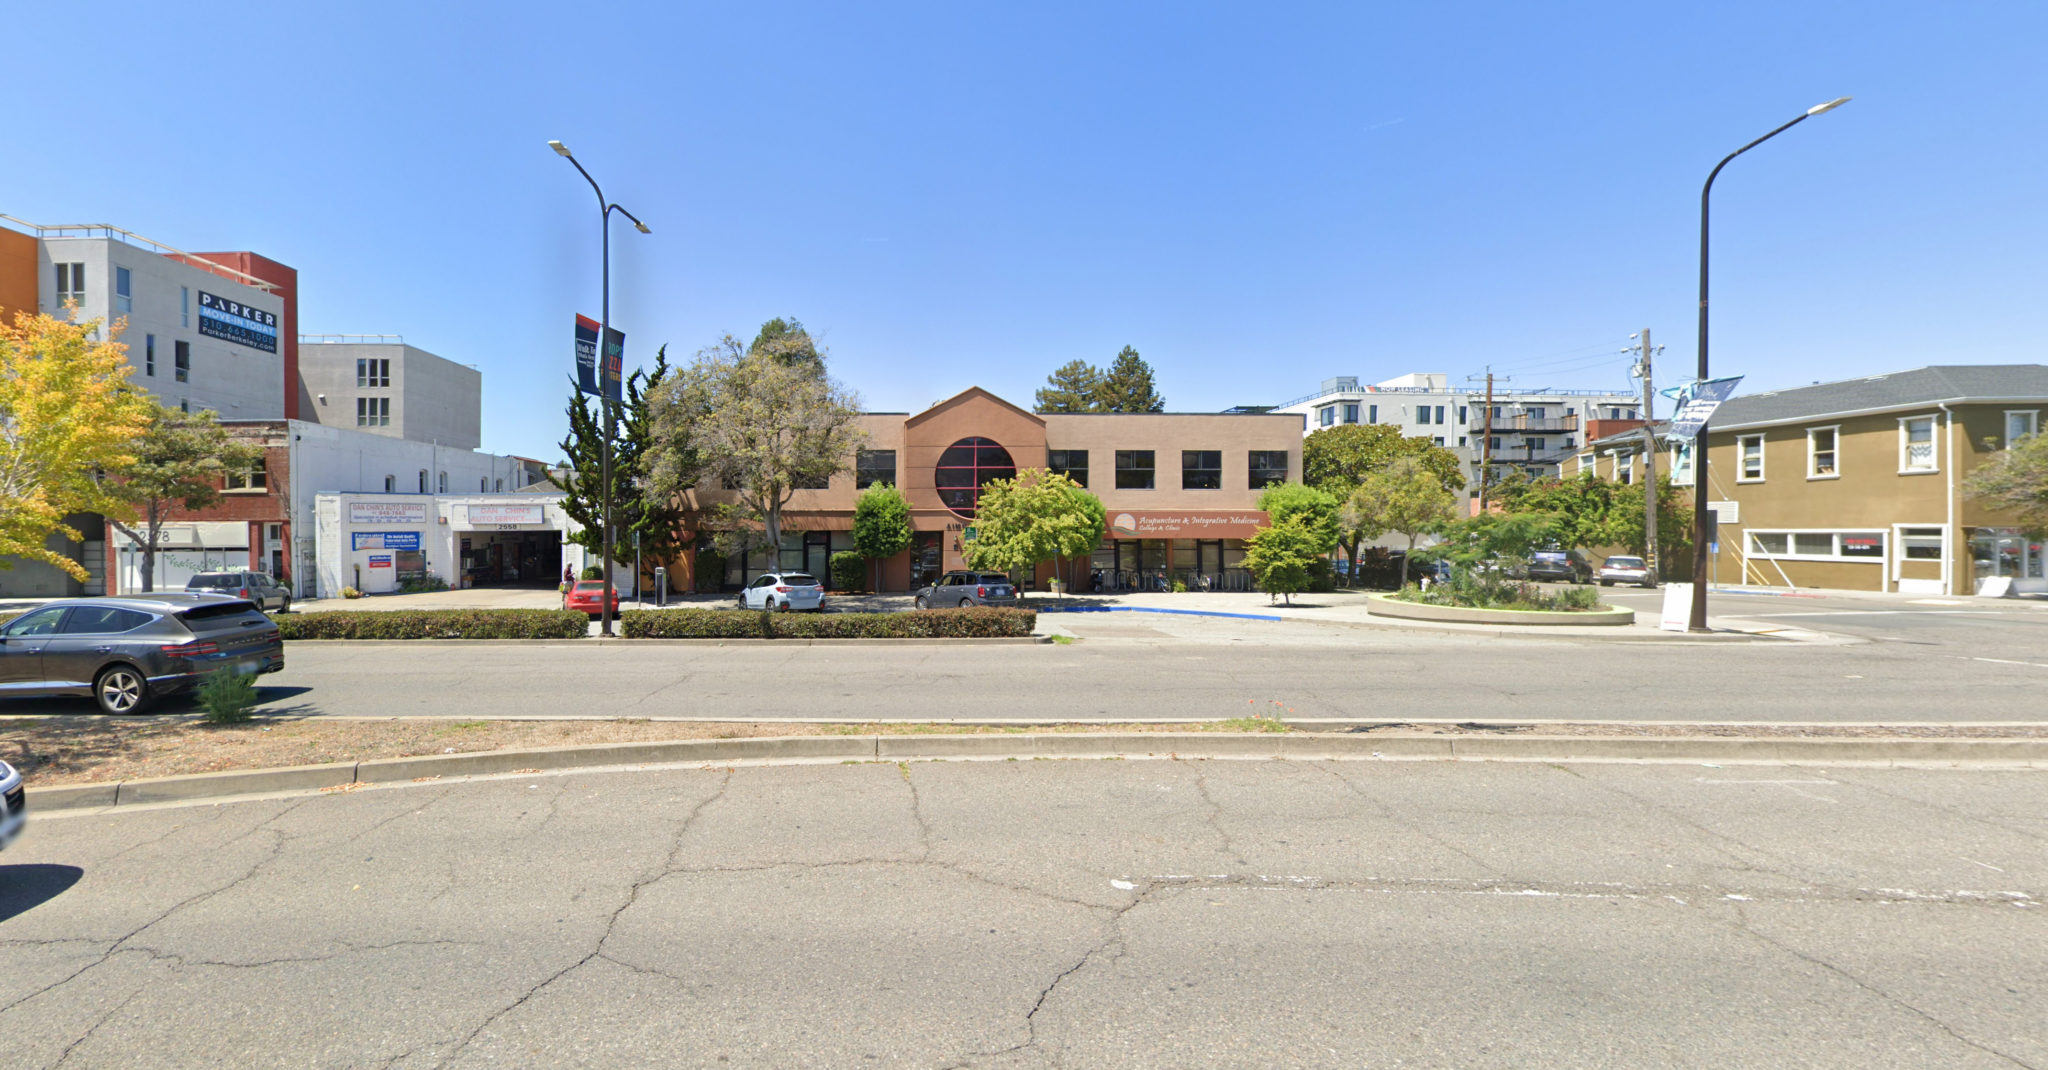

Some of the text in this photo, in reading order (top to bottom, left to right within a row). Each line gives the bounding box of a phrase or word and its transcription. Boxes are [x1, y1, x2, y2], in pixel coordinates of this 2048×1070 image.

[202, 294, 274, 326] PARKER
[203, 307, 274, 334] MOVE-IN TODAY
[1139, 515, 1260, 527] Acupuncture & Integrative Medicine
[139, 530, 170, 542] 278
